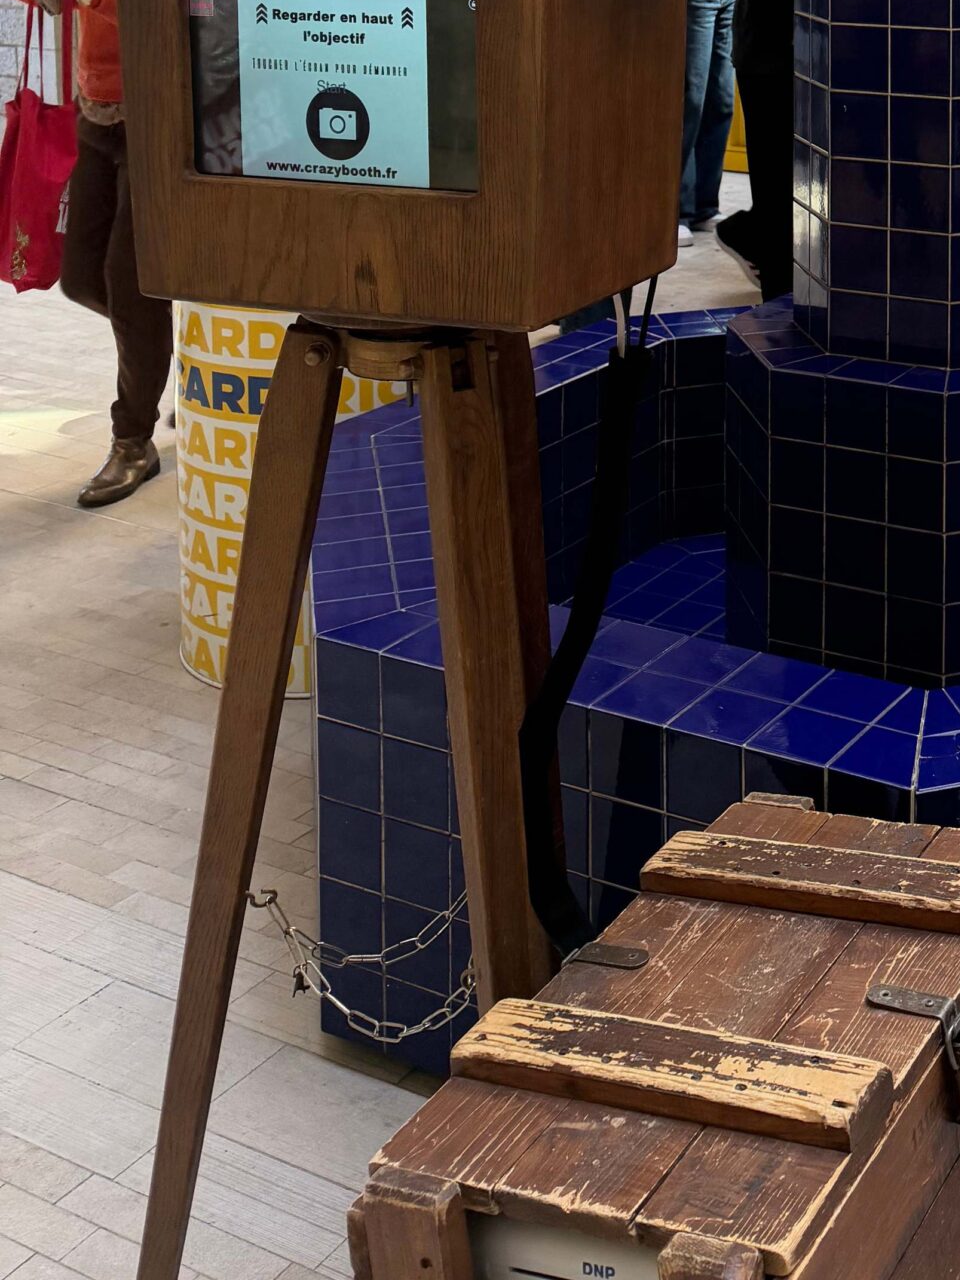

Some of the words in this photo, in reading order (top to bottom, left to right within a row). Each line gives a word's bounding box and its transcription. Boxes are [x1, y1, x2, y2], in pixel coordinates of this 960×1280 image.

[272, 8, 334, 24] Regarder
[340, 12, 357, 23] en
[361, 12, 394, 25] haut
[303, 30, 366, 46] l'objectif
[252, 57, 288, 71] TOUCHER
[335, 63, 356, 74] POUR
[317, 79, 346, 94] Start
[266, 160, 398, 179] www.crazybooth.fr
[582, 1261, 615, 1280] DNP
